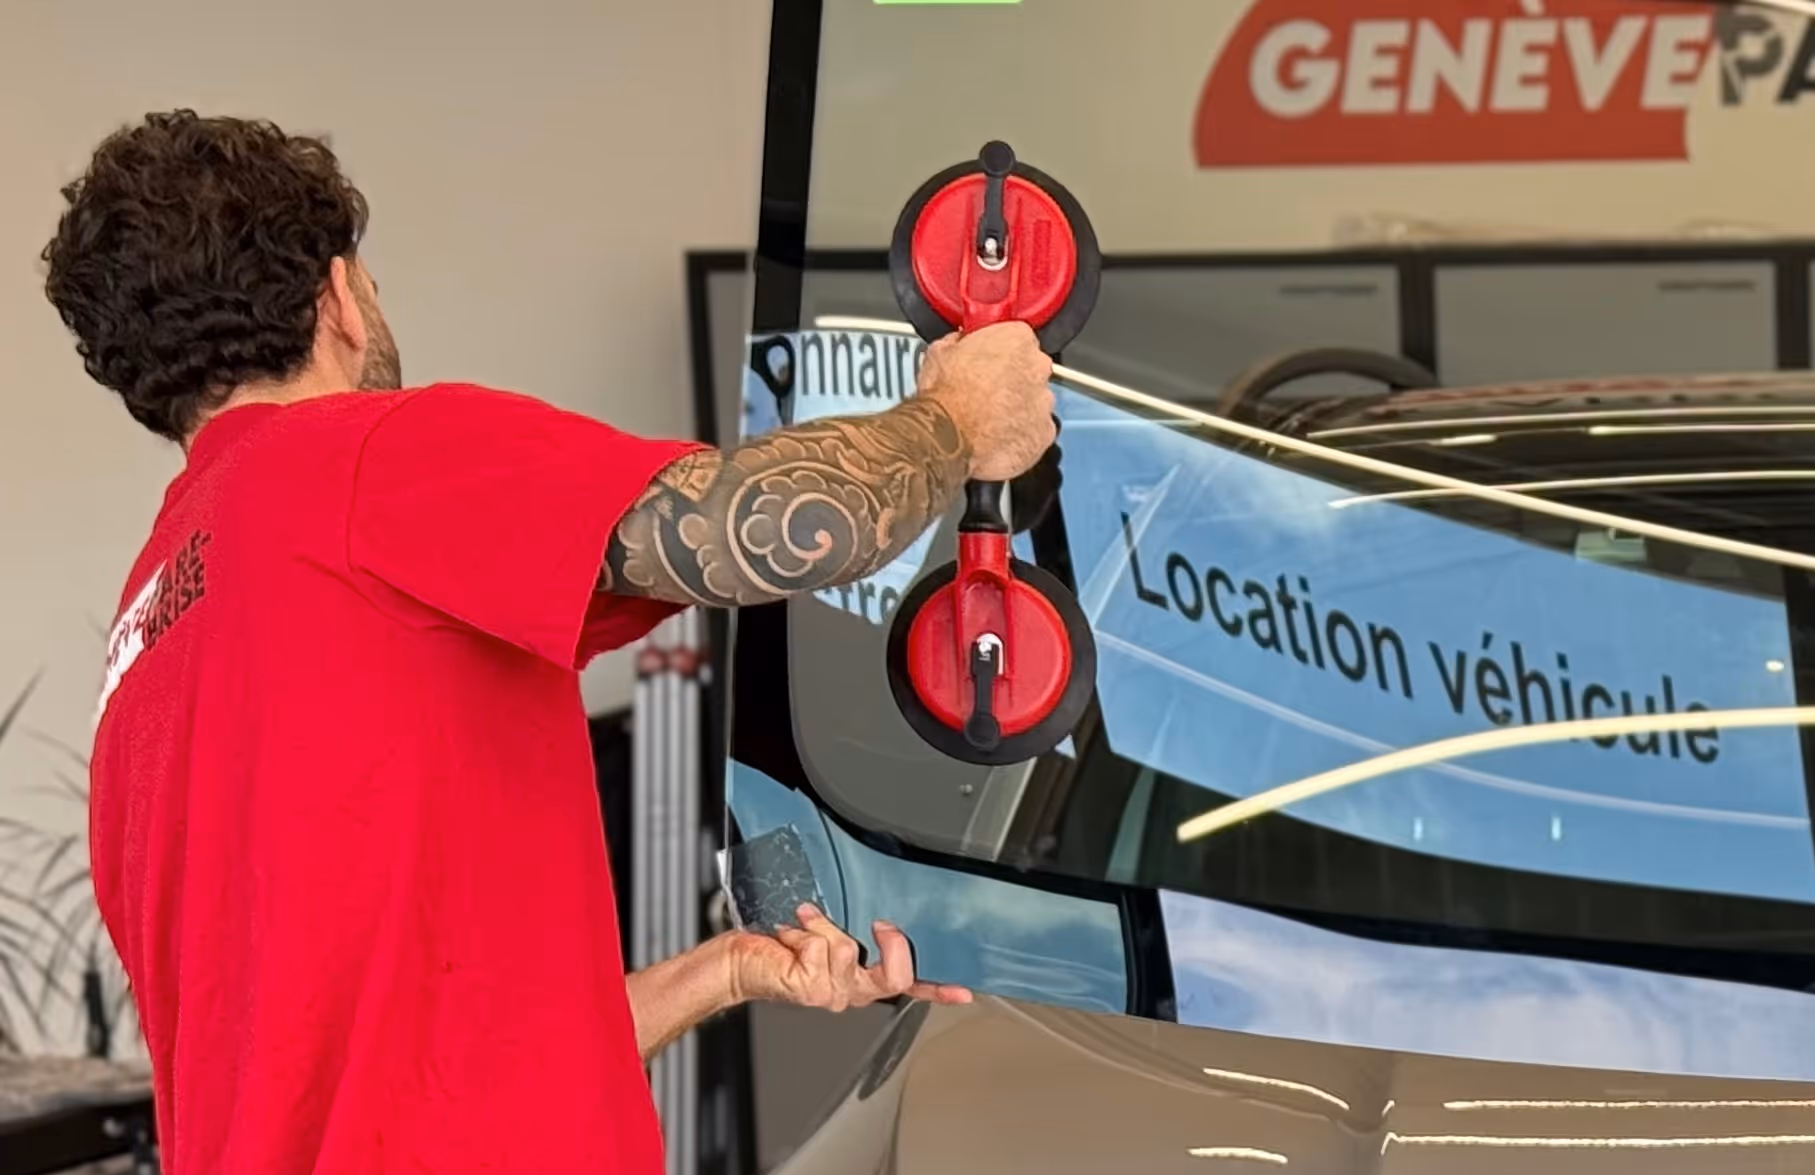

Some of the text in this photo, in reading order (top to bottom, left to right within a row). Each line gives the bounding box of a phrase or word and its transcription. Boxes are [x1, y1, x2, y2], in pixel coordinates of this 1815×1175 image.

[1248, 0, 1712, 118] GENÈVE
[1121, 512, 1720, 764] Location véhicule
